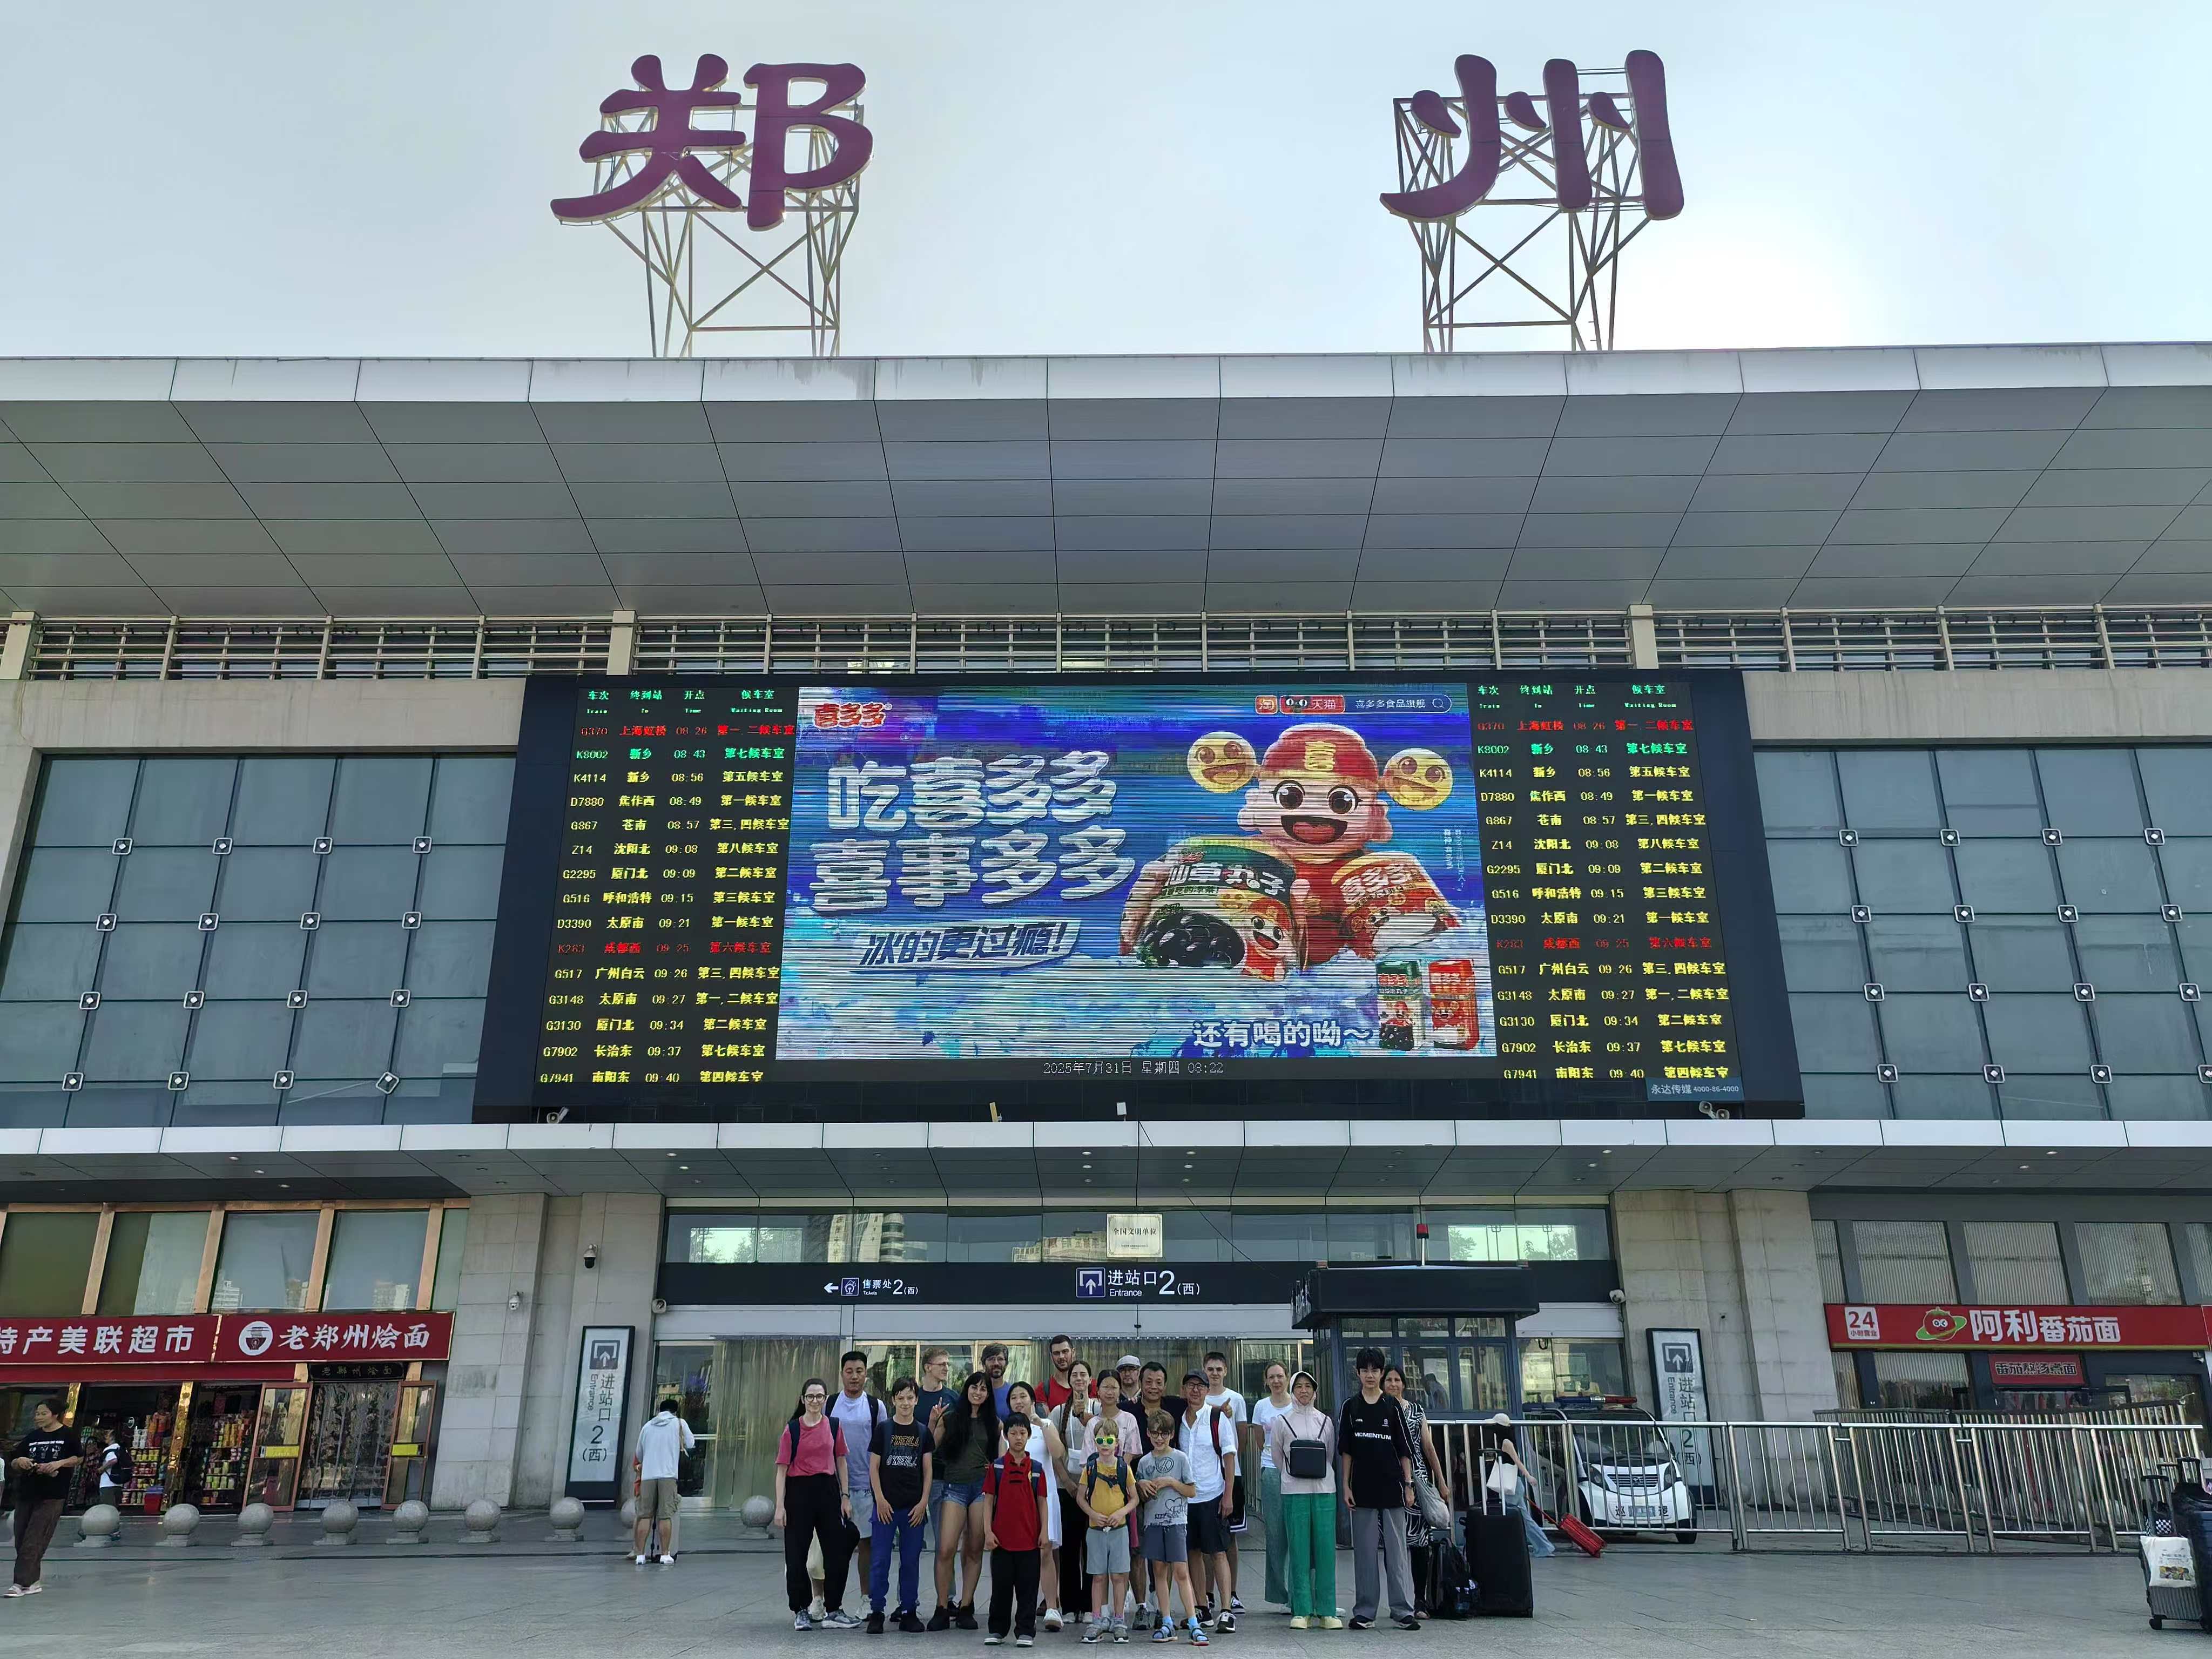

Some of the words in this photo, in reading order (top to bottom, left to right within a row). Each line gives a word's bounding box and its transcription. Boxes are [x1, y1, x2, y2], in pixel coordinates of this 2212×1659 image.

[550, 53, 874, 231] 郑
[1379, 49, 1685, 221] 州
[588, 691, 609, 700] 车次
[684, 690, 705, 700] 开点
[741, 689, 774, 699] 候车室
[1478, 685, 1499, 695] 车次
[1574, 684, 1596, 694] 开点
[1632, 684, 1665, 694] 候车室
[1312, 699, 1336, 709] 天猫
[629, 748, 652, 759] 新乡
[724, 747, 785, 759] 第七候车室
[1478, 745, 1509, 754] K8002
[1531, 743, 1553, 754] 新乡
[1626, 742, 1688, 754] 第七候车室
[574, 773, 606, 783] K4114
[627, 771, 650, 783] 新乡
[672, 773, 704, 782] 08:56
[722, 770, 783, 783] 第五候车室
[1479, 769, 1512, 778] K4114
[1533, 766, 1556, 778] 新乡
[1578, 768, 1610, 777] 08:56
[1629, 766, 1690, 777] 第五候车室
[828, 750, 1116, 832] 吃喜多多
[1480, 792, 1515, 801] D7880
[1530, 790, 1566, 802] 焦作西
[1581, 792, 1613, 801] 08:49
[1631, 790, 1694, 801] 第一候车室
[570, 797, 604, 806] D7880
[618, 795, 656, 807] 焦作西
[669, 797, 702, 806] 08:49
[720, 794, 782, 806] 第一候车室
[571, 821, 598, 830] G867
[622, 819, 647, 831] 苍南
[1486, 816, 1512, 825] G867
[1536, 814, 1562, 826] 苍南
[571, 845, 592, 854] Z14
[613, 842, 651, 854] 沈阳北
[665, 845, 698, 854] 09:08
[717, 842, 778, 854] 第八候车室
[1492, 840, 1512, 849] Z14
[1534, 839, 1572, 849] 沈阳北
[1585, 840, 1618, 849] 09:08
[1637, 838, 1700, 849] 第八候车室
[563, 869, 596, 879] G2295
[611, 867, 649, 880] 厦门北
[663, 869, 696, 878] 09:09
[715, 866, 777, 879] 第二候车室
[810, 826, 1136, 912] 喜事多多
[1487, 865, 1520, 874] G2295
[1536, 862, 1574, 874] 厦门北
[1588, 864, 1621, 873] 09:09
[1640, 862, 1703, 874] 第二候车室
[563, 894, 590, 903] G516
[603, 892, 652, 904] 呼和浩特
[713, 891, 775, 903] 第三候车室
[1492, 889, 1519, 899] G516
[1532, 887, 1582, 899] 呼和浩特
[1642, 886, 1706, 899] 第三候车室
[557, 919, 592, 928] D3390
[606, 916, 644, 929] 太原南
[659, 919, 690, 928] 09:21
[711, 915, 774, 928] 第一候车室
[1491, 914, 1526, 924] D3390
[1541, 912, 1578, 924] 太原南
[1593, 914, 1624, 923] 09:21
[1645, 911, 1709, 923] 第一候车室
[555, 969, 582, 979] G517
[595, 967, 645, 980] 广州白云
[1498, 965, 1525, 974] G517
[1539, 962, 1589, 975] 广州白云
[549, 995, 584, 1004] G3148
[598, 992, 637, 1005] 太原南
[1497, 990, 1532, 1000] G3148
[1548, 988, 1586, 1001] 太原南
[546, 1021, 581, 1030] G3130
[596, 1019, 635, 1031] 厦门北
[650, 1020, 683, 1030] 09:34
[703, 1018, 767, 1030] 第二候车室
[1500, 1016, 1535, 1027] G3130
[1550, 1014, 1589, 1027] 厦门北
[1604, 1016, 1638, 1026] 09:34
[1657, 1013, 1722, 1026] 第二候车室
[543, 1047, 578, 1057] G7902
[594, 1044, 633, 1057] 长治东
[648, 1046, 681, 1056] 09:37
[702, 1044, 765, 1057] 第七候车室
[1501, 1042, 1536, 1053] G7902
[1552, 1040, 1591, 1053] 长治东
[1607, 1042, 1640, 1052] 09:37
[1660, 1040, 1726, 1053] 第七候车室
[1043, 1061, 1132, 1075] 2025年7月31日
[1142, 1061, 1180, 1075] 星期四
[1188, 1062, 1224, 1073] 08:22
[1651, 1084, 1692, 1095] 永达传媒
[1114, 1227, 1156, 1235] 全国文明单位
[1849, 1311, 1874, 1328] 24
[1969, 1310, 2121, 1343] 阿利番茄面
[278, 1323, 431, 1352] 老郑州烩面
[1667, 1377, 1677, 1413] Entrance
[1354, 1432, 1392, 1440] MOMENTUM
